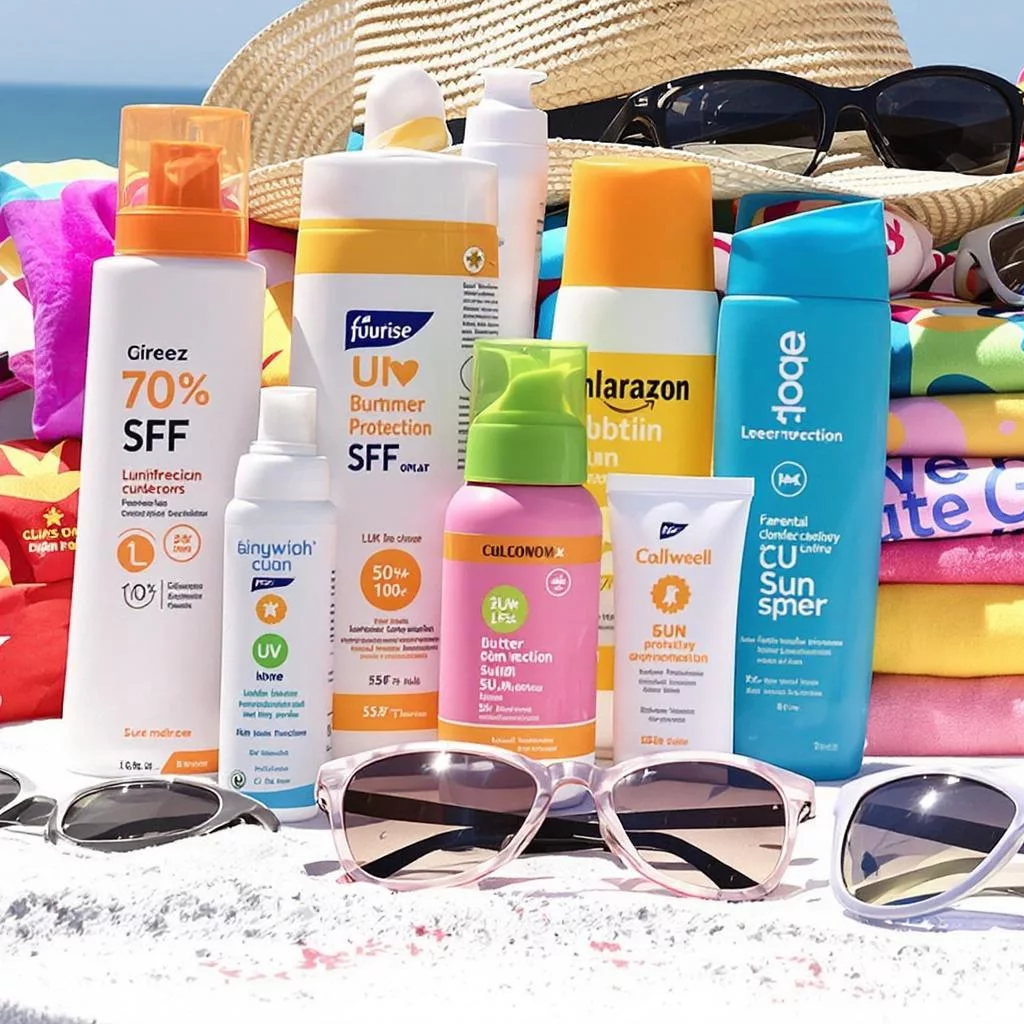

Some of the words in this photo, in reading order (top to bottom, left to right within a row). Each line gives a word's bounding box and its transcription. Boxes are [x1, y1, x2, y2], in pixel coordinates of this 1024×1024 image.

[127, 345, 188, 361] Gireez
[122, 370, 210, 410] 70%
[123, 418, 190, 452] SFF
[349, 418, 432, 436] Protection
[347, 443, 400, 471] SFF
[760, 571, 815, 596] Sun
[257, 643, 281, 659] UV
